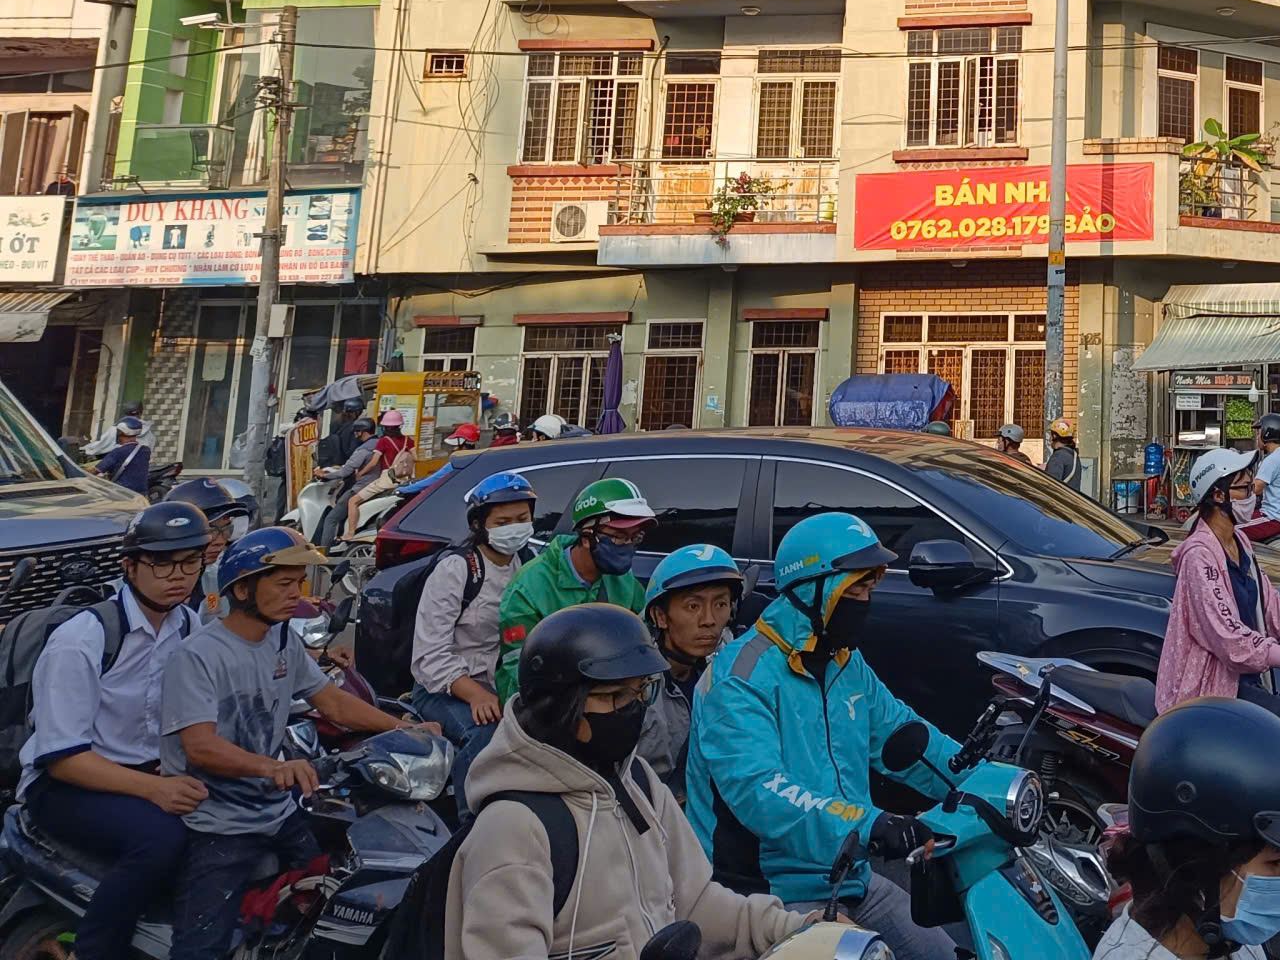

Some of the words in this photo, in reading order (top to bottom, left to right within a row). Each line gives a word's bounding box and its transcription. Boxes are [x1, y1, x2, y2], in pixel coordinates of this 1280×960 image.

[935, 178, 997, 207] BÁN
[126, 200, 168, 222] DUY
[175, 198, 249, 221] KHANG
[890, 214, 1051, 241] 0762.028.179
[298, 423, 316, 442] 10K
[575, 496, 597, 512] Grab
[779, 559, 804, 577] XANH
[333, 904, 375, 925] YAMAHA
